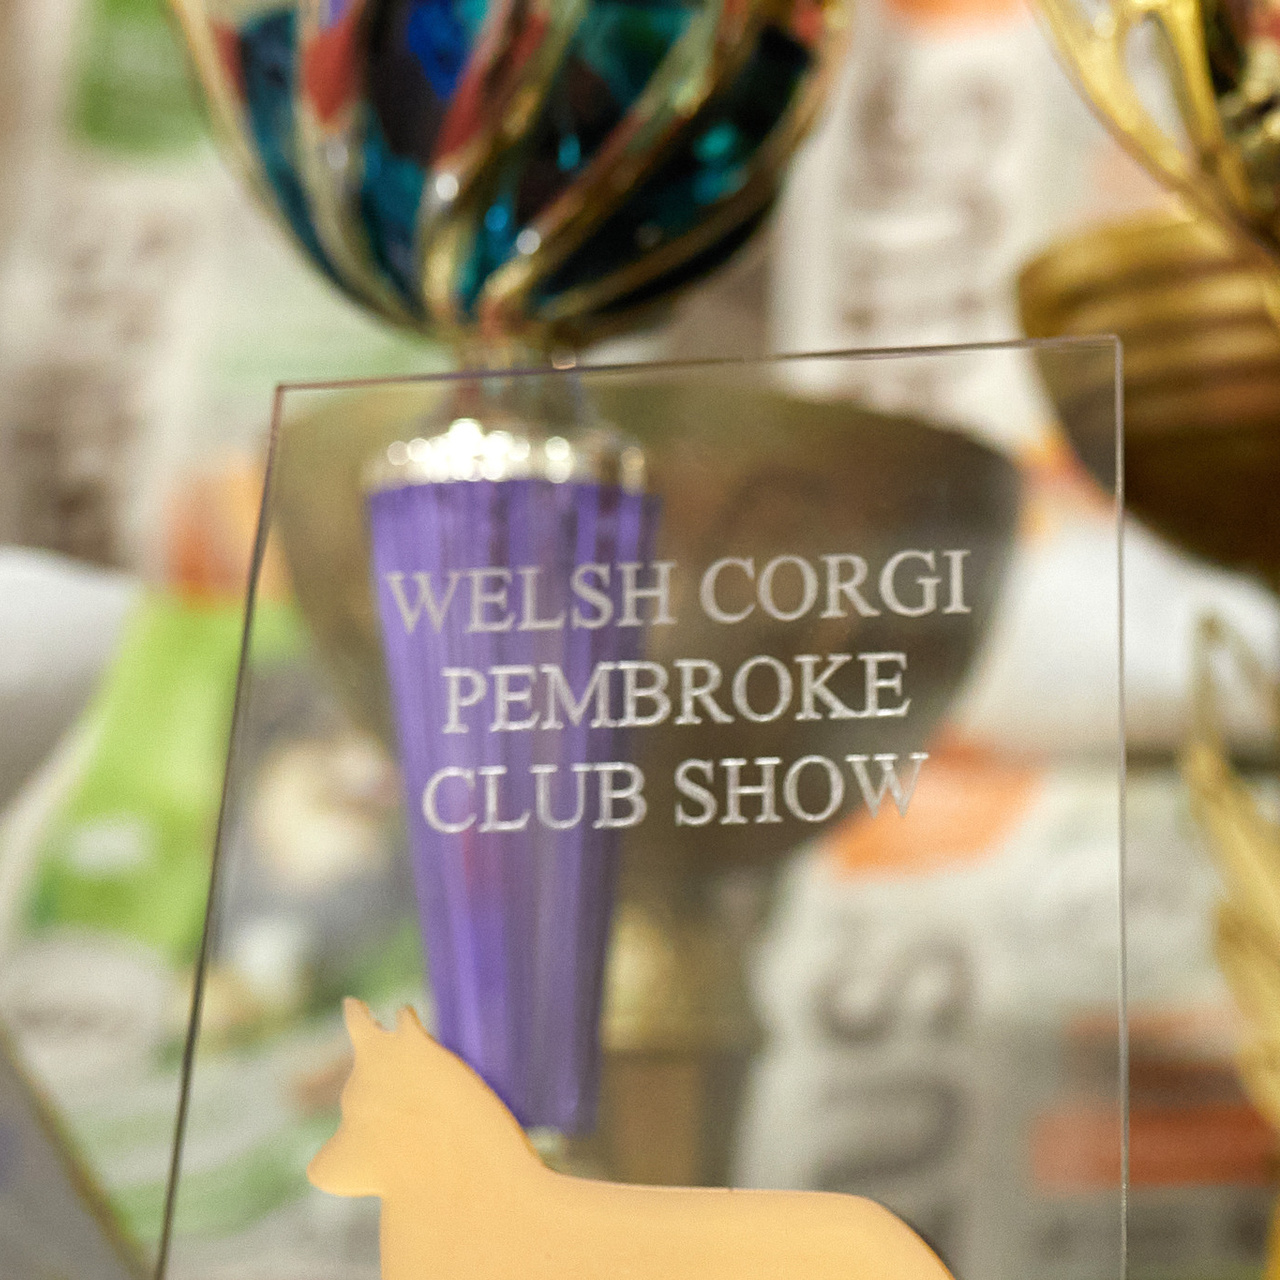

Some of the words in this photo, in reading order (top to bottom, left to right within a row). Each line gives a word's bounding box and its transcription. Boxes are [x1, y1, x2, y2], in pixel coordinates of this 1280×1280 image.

[386, 560, 678, 635] WELSH
[701, 549, 972, 625] CORGI
[441, 652, 912, 734] PEMBROKE
[422, 761, 648, 834] CLUB
[674, 751, 929, 827] SHOW
